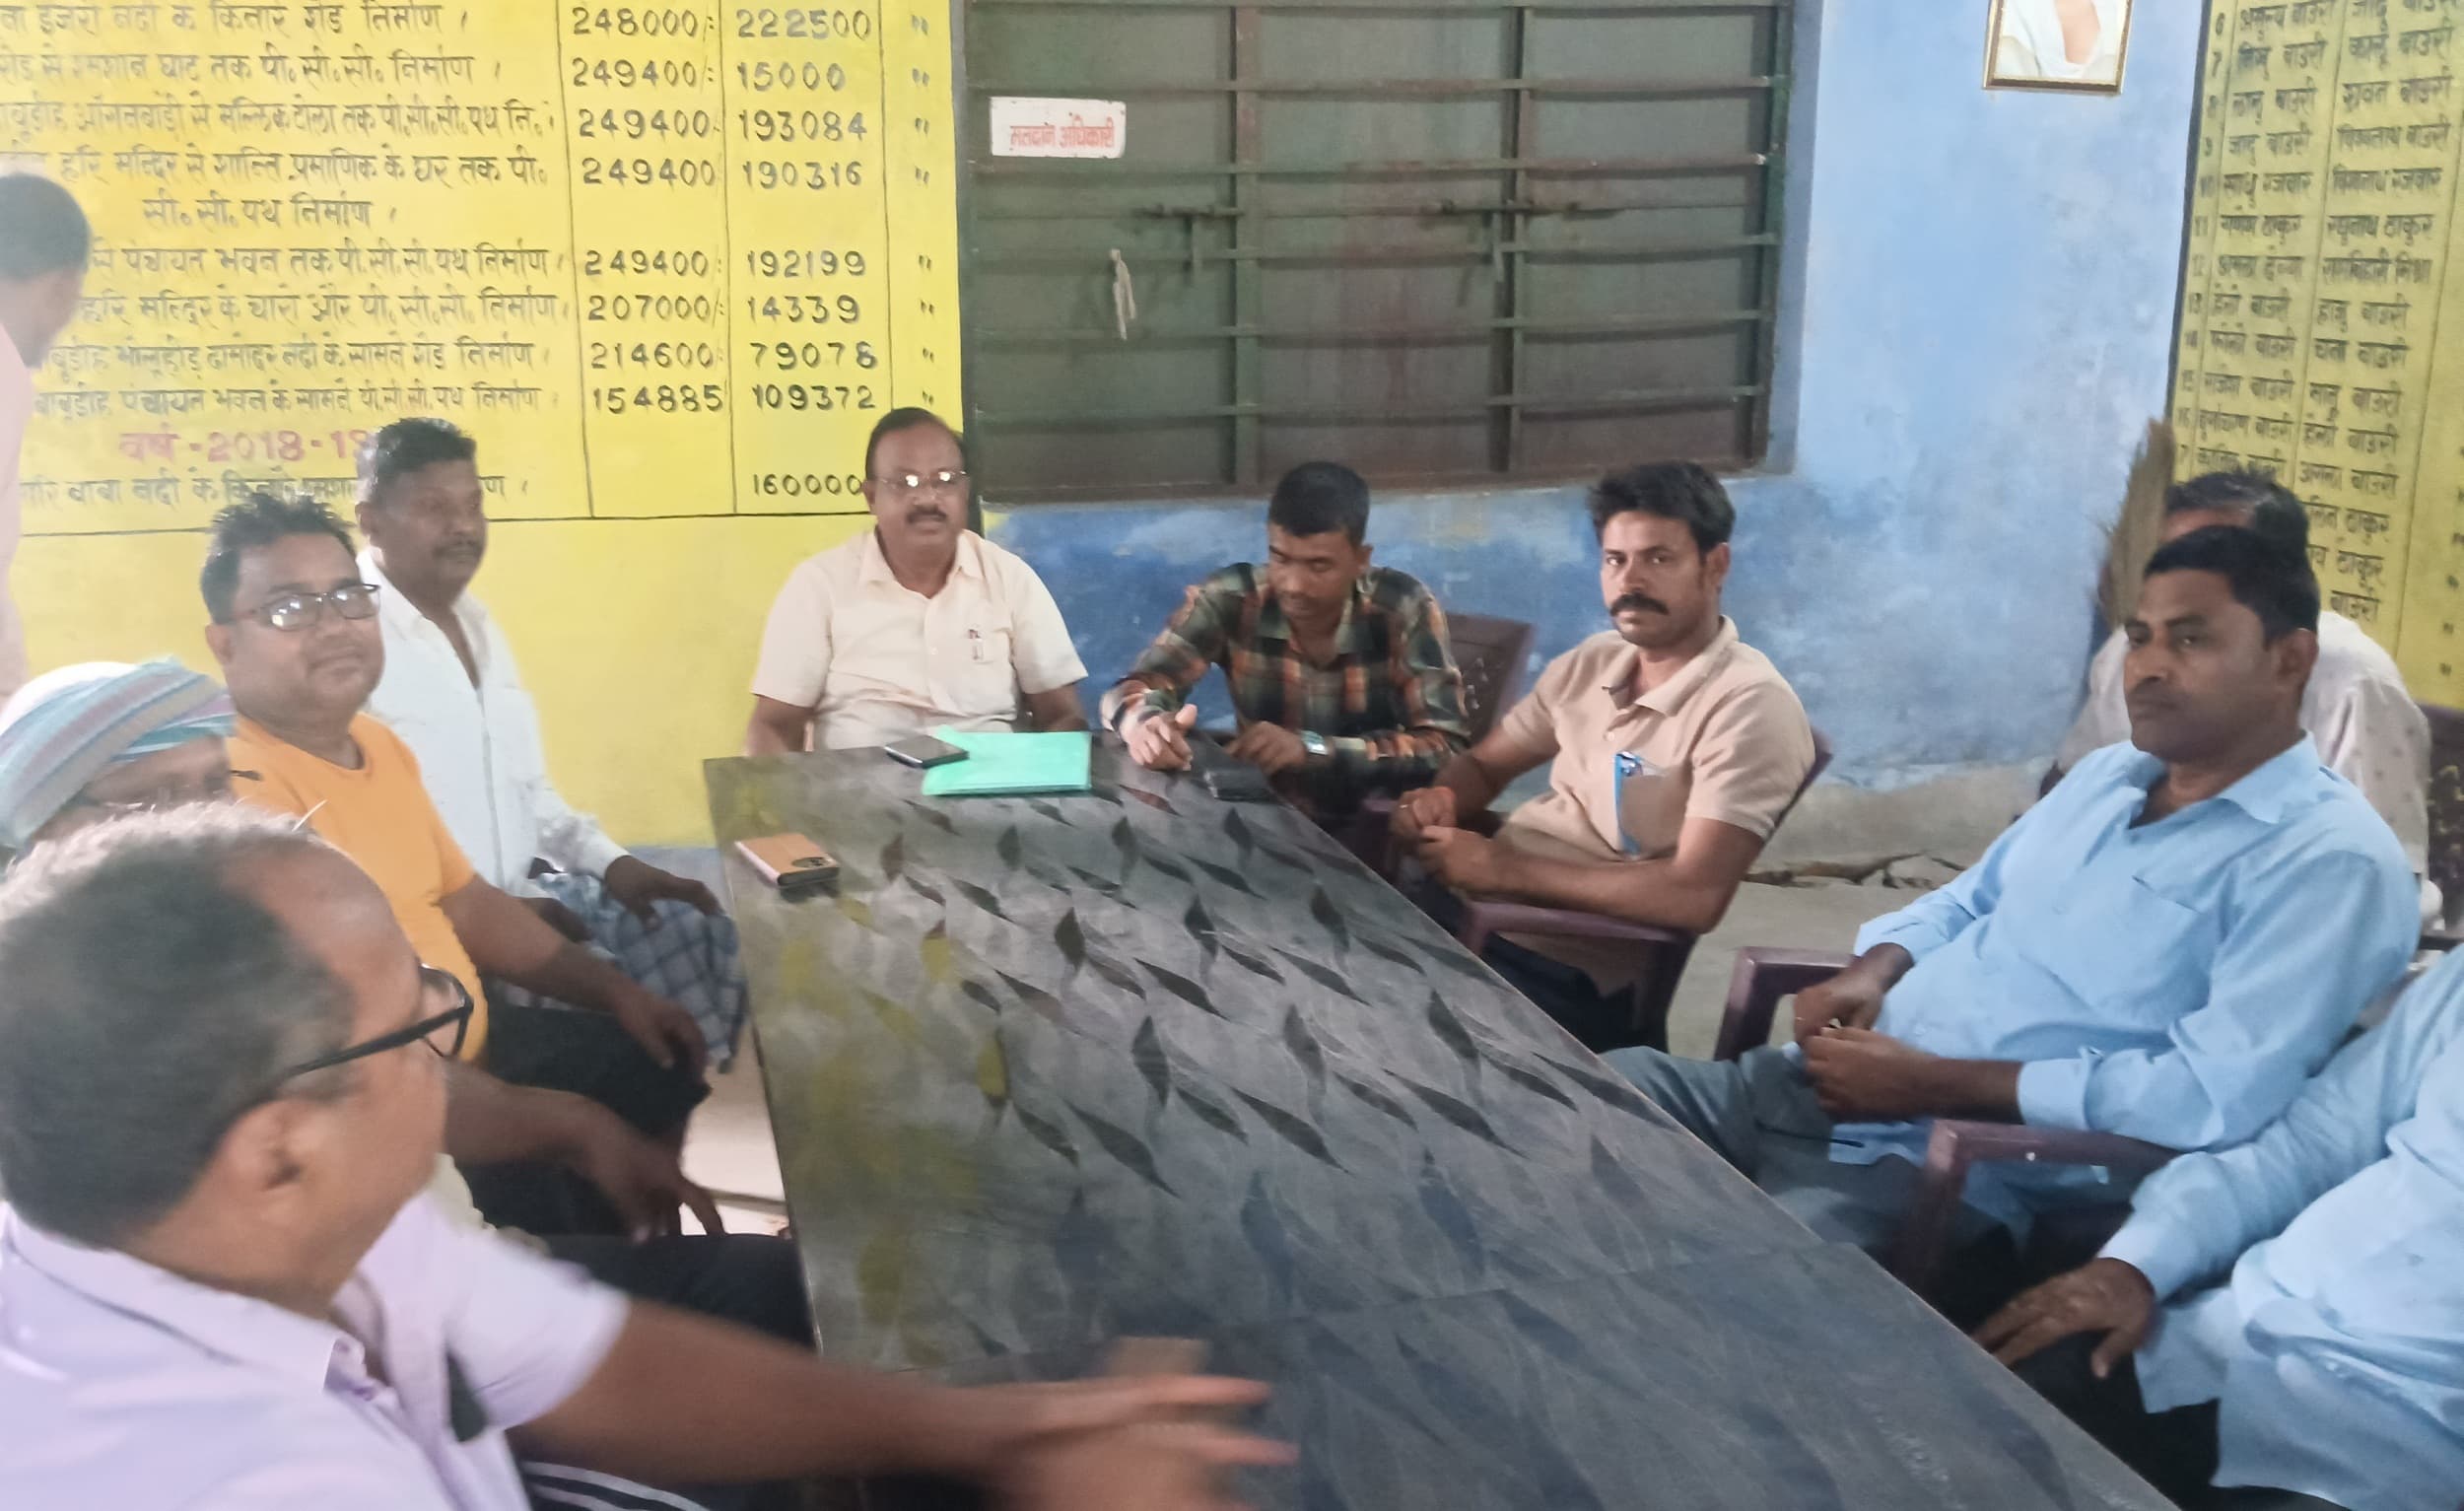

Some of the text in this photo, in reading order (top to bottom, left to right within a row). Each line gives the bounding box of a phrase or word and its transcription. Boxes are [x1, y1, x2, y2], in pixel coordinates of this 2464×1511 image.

[736, 9, 872, 39] 222500
[209, 54, 252, 83] तक
[388, 43, 475, 87] निर्माण
[737, 61, 847, 91] 15000
[343, 103, 376, 137] तक
[738, 109, 868, 142] 193084
[384, 142, 406, 183] के
[412, 155, 451, 187] घर
[458, 156, 502, 185] तक
[743, 161, 864, 189] 190316
[290, 190, 373, 230] निर्माण
[288, 247, 334, 276] तक
[473, 238, 550, 278] निर्माण
[747, 249, 866, 276] 192199
[477, 286, 559, 326] निर्माण
[747, 294, 859, 323] 14339
[454, 335, 536, 372] निर्माण
[470, 380, 543, 413] निर्माण
[752, 384, 877, 412] 109372
[753, 473, 863, 497] 160000
